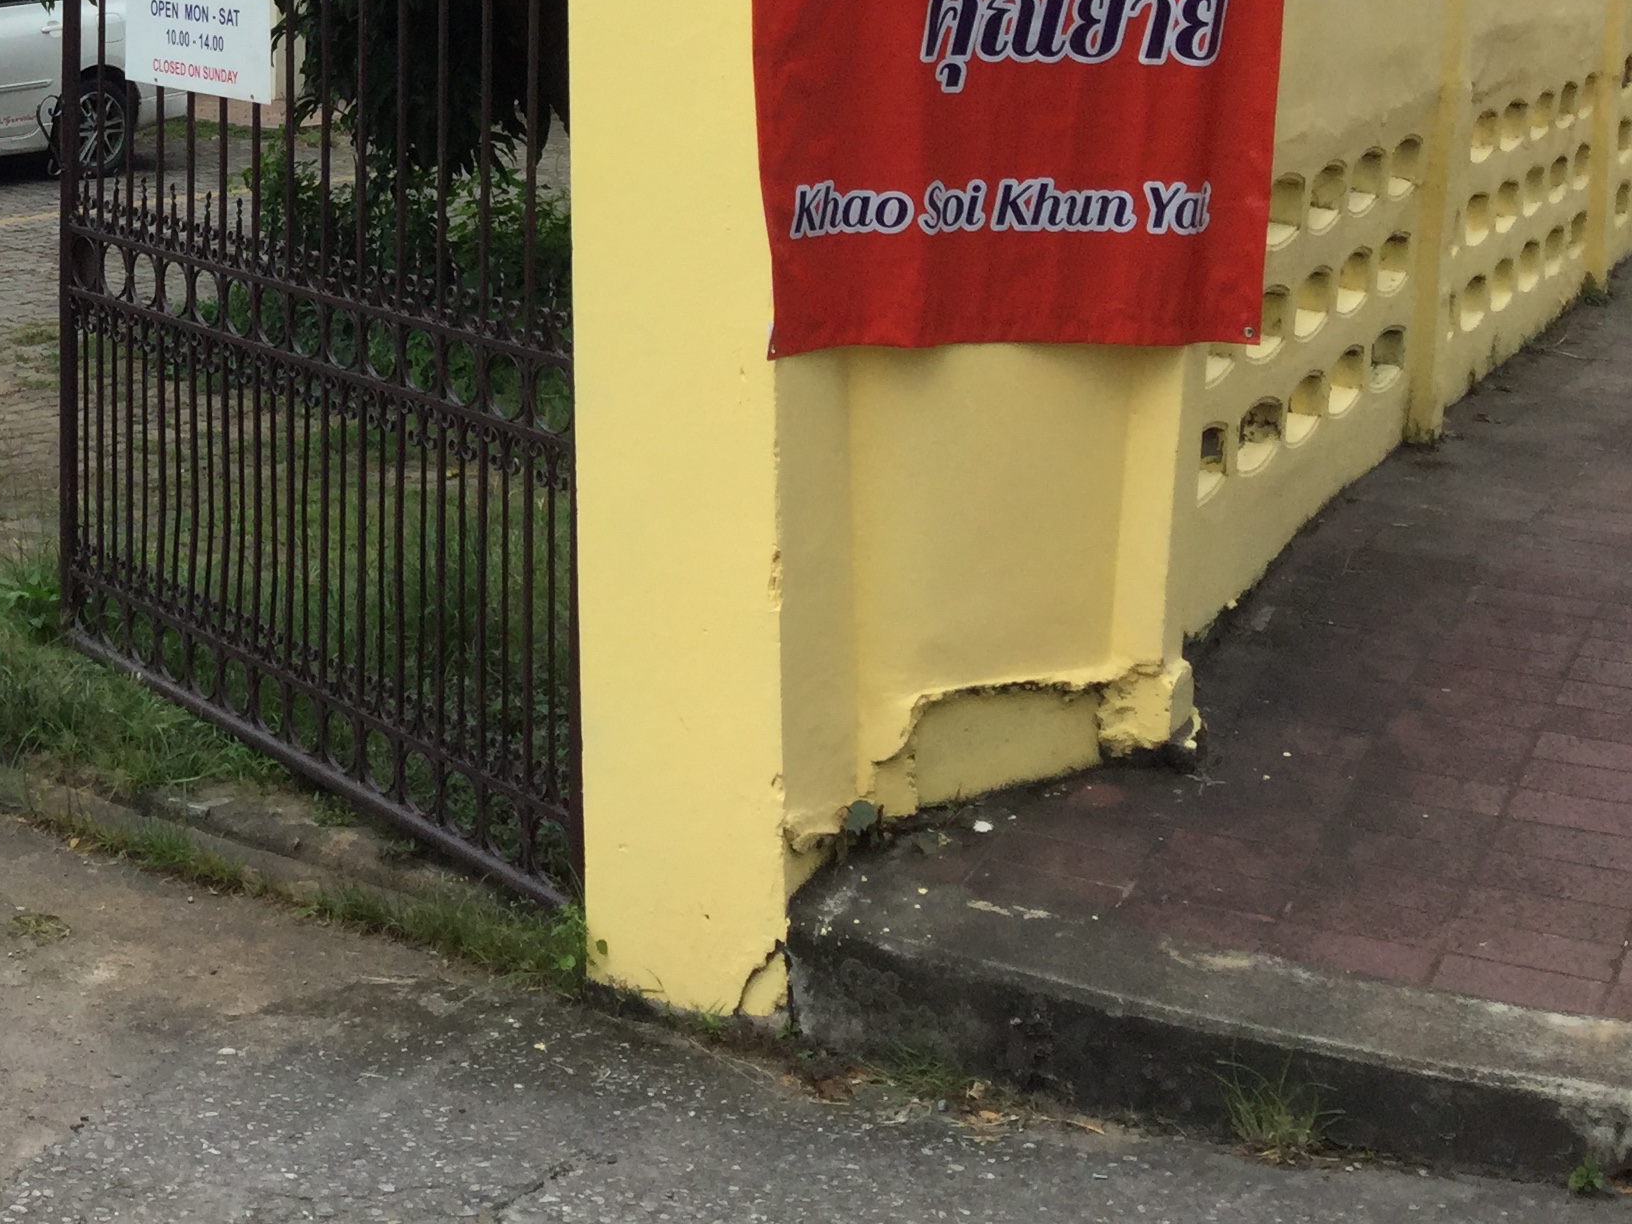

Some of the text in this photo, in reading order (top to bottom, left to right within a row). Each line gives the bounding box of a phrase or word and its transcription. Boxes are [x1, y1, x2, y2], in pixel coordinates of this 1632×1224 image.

[150, 0, 179, 20] OPEN
[184, 3, 209, 23] MON
[219, 7, 240, 27] SAT
[166, 29, 190, 48] 10.00
[199, 34, 224, 53] 14.00
[152, 58, 239, 85] CLOSED ON SUNDAY
[790, 178, 1210, 239] Khao Soi Khun Yai
